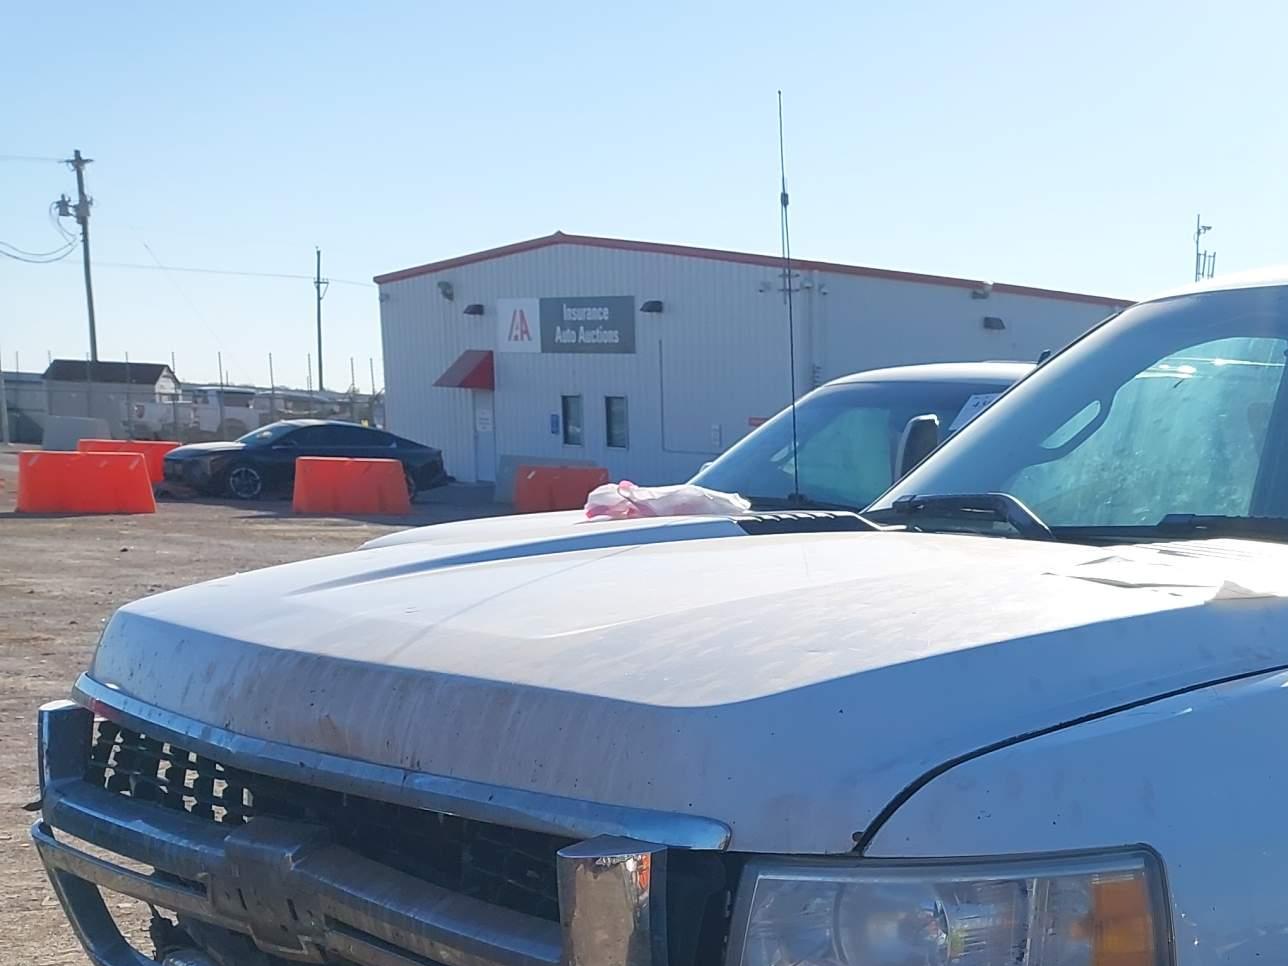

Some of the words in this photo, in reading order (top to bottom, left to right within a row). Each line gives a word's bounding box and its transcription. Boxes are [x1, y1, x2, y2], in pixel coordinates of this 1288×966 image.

[562, 303, 609, 321] Insurance
[555, 325, 577, 343] Auto
[578, 325, 619, 344] Auctions
